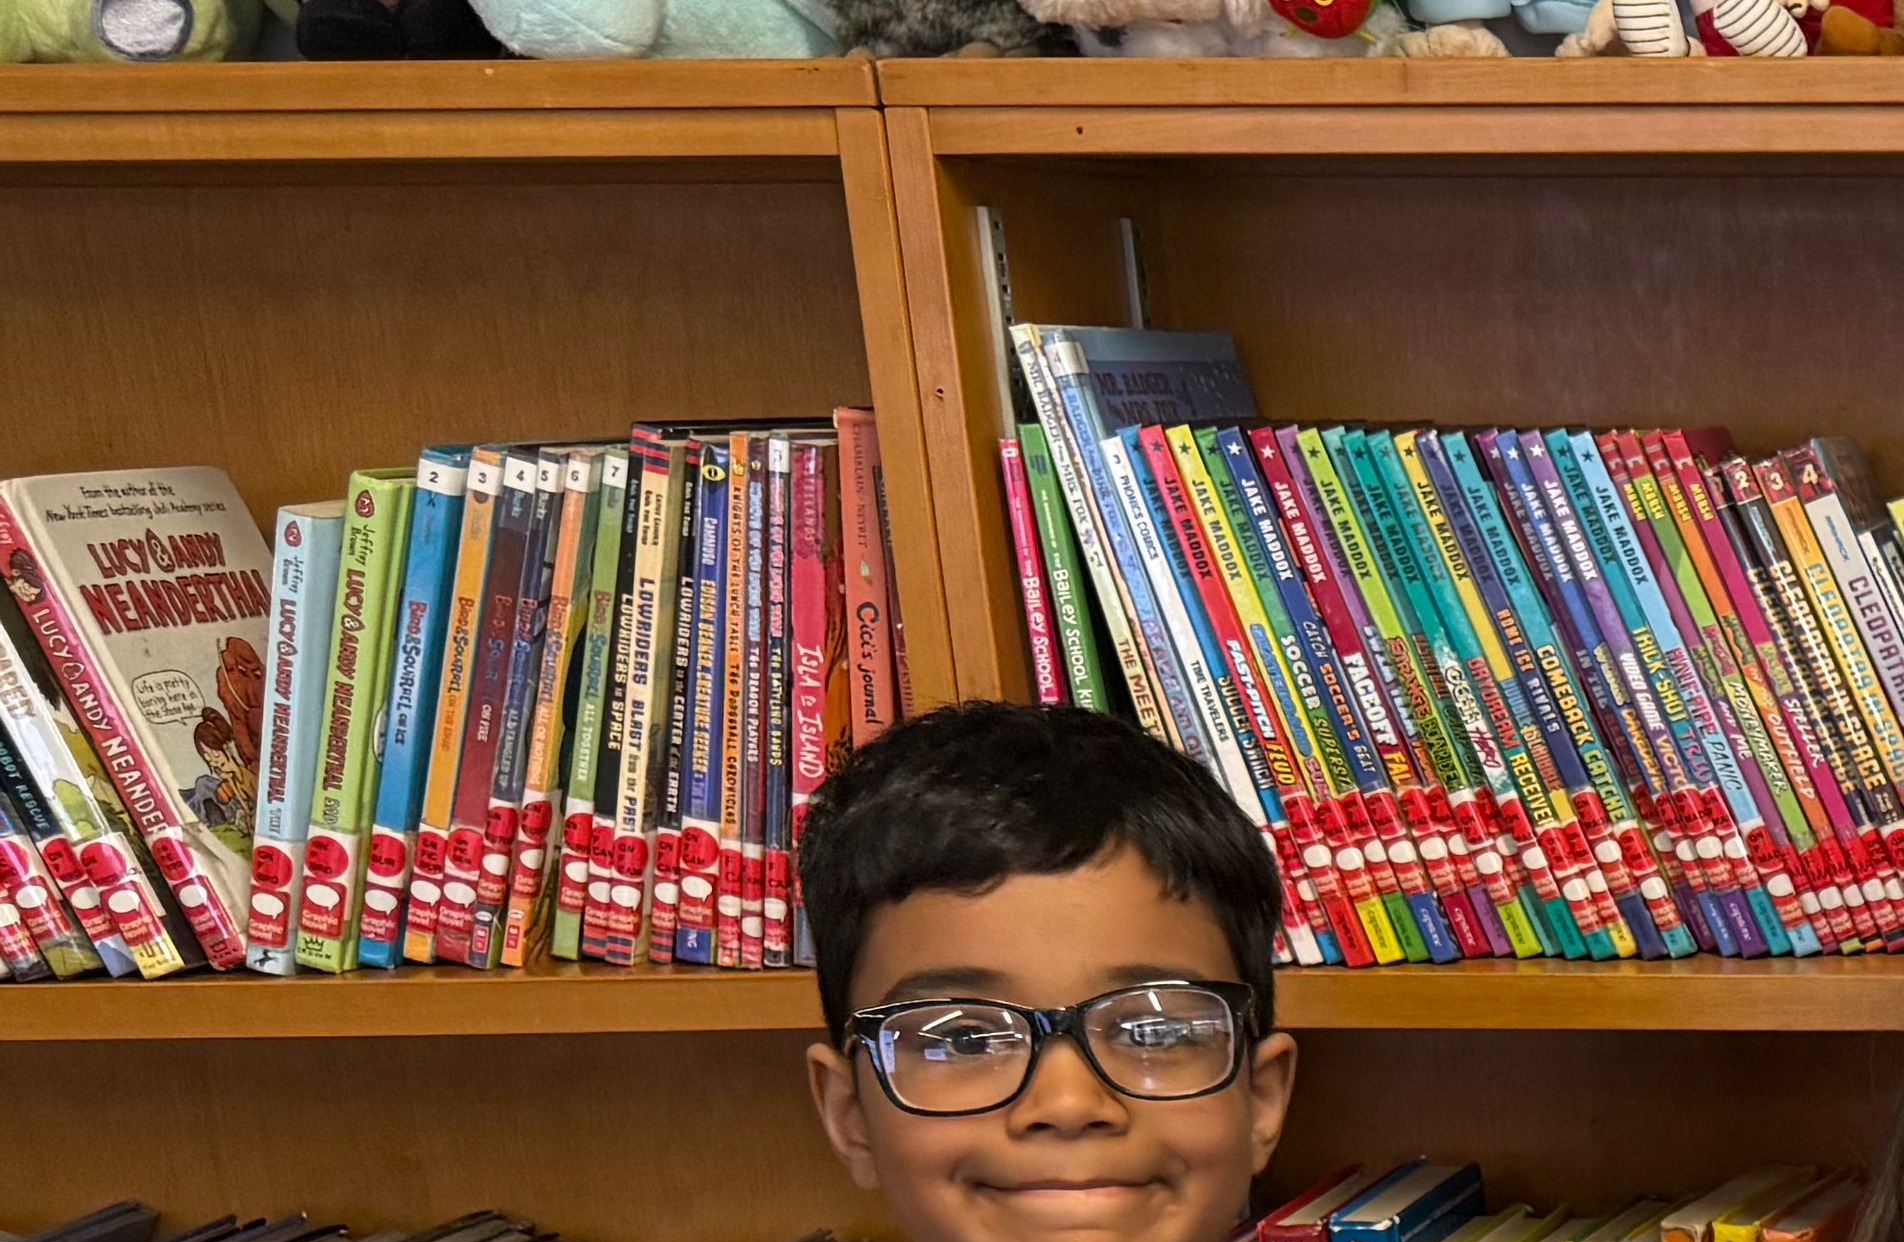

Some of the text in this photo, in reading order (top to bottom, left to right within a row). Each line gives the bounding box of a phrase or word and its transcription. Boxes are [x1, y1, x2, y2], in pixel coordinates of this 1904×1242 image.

[87, 531, 226, 579] LUCY ANDY
[1164, 477, 1213, 580] JAKE MADDOX
[1192, 479, 1243, 582] JAKE MADDOX
[1220, 479, 1271, 582] JAKE MADDOX
[1241, 478, 1294, 582] JAKE MADDOX
[1274, 481, 1328, 584] JAKE MADDOX
[1319, 479, 1373, 581] JAKE MADDOX
[1417, 481, 1472, 582] JAKE MADDOX
[1467, 485, 1523, 588] JAKE MADDOX
[1543, 480, 1599, 582] JAKE MADDOX
[279, 598, 296, 645] LUCY
[346, 568, 366, 614] LUCY
[630, 577, 655, 686] LOWRIDERS
[33, 607, 113, 731] LUCY ANDY
[1226, 639, 1298, 786] FAST-PITCH FEUD
[1281, 634, 1323, 711] SOCCER
[1320, 662, 1377, 774] SOCCER'S BEAT
[1342, 652, 1400, 746] FACEOFF
[1537, 644, 1595, 747] COMEBACK
[1618, 652, 1648, 692] VIDEO
[1631, 625, 1690, 724] TRICK-SHOT
[1706, 740, 1744, 792] PANIC
[1728, 680, 1789, 798] MONEYMAKER
[1767, 713, 1815, 800] OUTFIELD
[1838, 717, 1887, 791] SPACE
